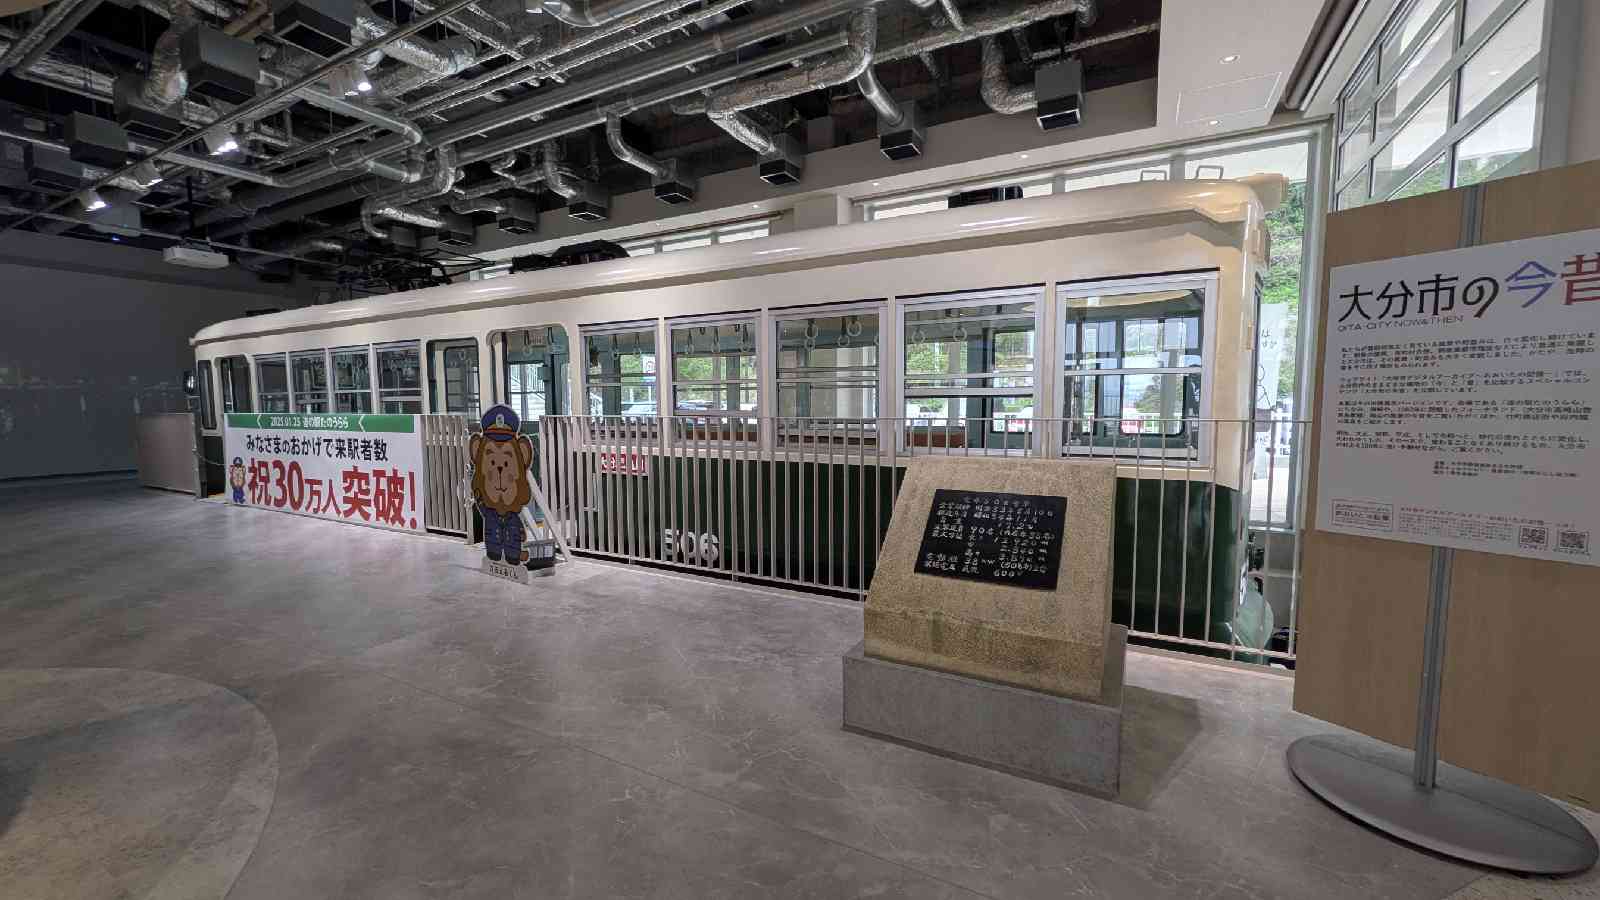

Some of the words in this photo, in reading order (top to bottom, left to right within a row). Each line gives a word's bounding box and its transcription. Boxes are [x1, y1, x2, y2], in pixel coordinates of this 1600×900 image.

[1338, 252, 1600, 321] 大分市の今昔
[246, 434, 389, 462] みなさまのおかげで来駅者数
